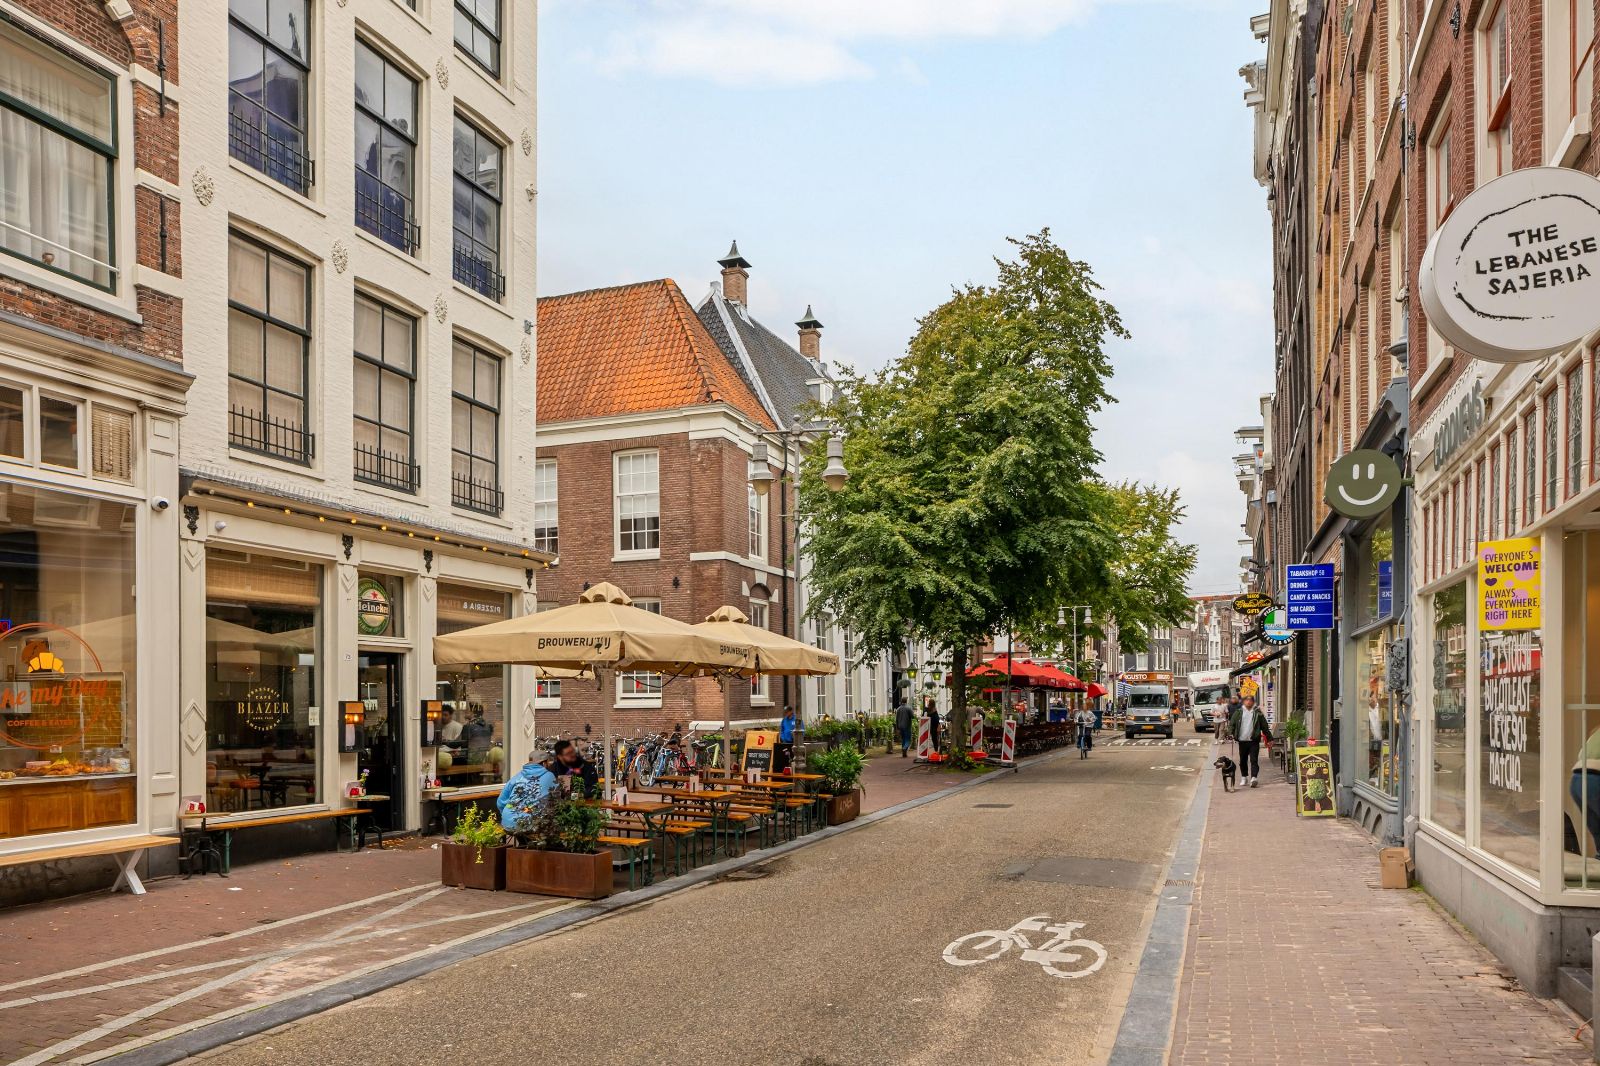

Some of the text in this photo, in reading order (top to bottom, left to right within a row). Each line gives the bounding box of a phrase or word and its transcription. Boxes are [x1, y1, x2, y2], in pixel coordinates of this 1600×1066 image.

[1508, 224, 1558, 247] THE
[1476, 237, 1597, 274] LEBANESE
[1488, 263, 1591, 295] SAJERIA
[1485, 550, 1534, 563] EVERYONE'S
[1485, 561, 1539, 574] WELCOME
[1485, 588, 1519, 599] ALWAYS,
[1485, 597, 1540, 610] EVERYWHERE,
[1485, 608, 1533, 621] RIGHT HERE
[32, 684, 64, 707] my
[238, 702, 289, 714] BLAZER
[7, 719, 40, 727] COFFEE
